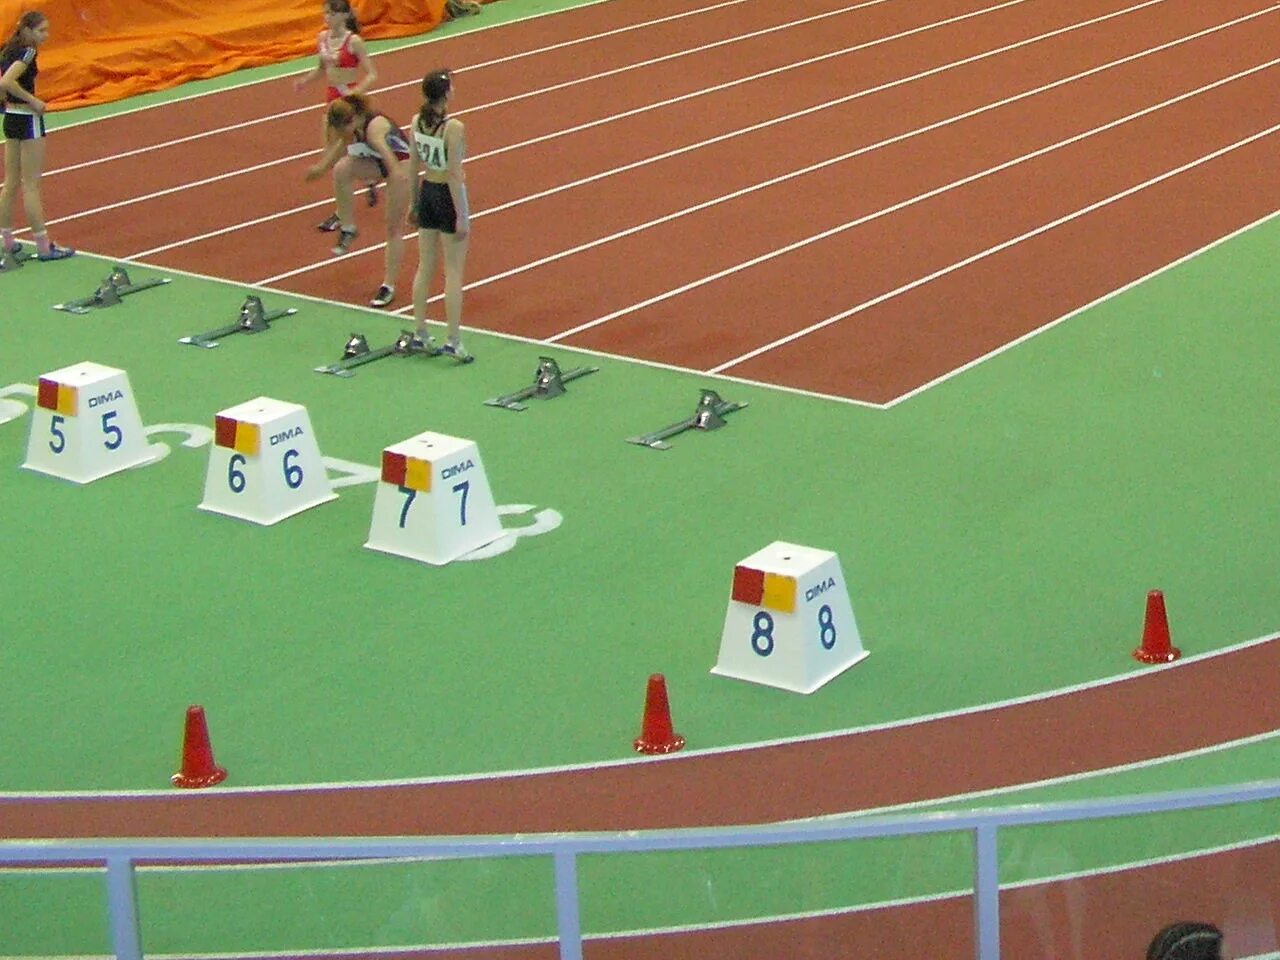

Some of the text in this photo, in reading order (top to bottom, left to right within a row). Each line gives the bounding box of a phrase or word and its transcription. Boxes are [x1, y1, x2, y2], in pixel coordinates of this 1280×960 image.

[88, 390, 124, 408] DIMA
[48, 415, 65, 454] 5
[102, 410, 123, 450] 5
[269, 426, 304, 446] DIMA
[228, 453, 246, 493] 6
[282, 449, 304, 489] 6
[441, 459, 475, 480] DIMA
[398, 485, 416, 528] 7
[452, 480, 469, 526] 7
[805, 577, 836, 602] DIMA
[751, 610, 774, 657] 8
[818, 604, 836, 650] 8
